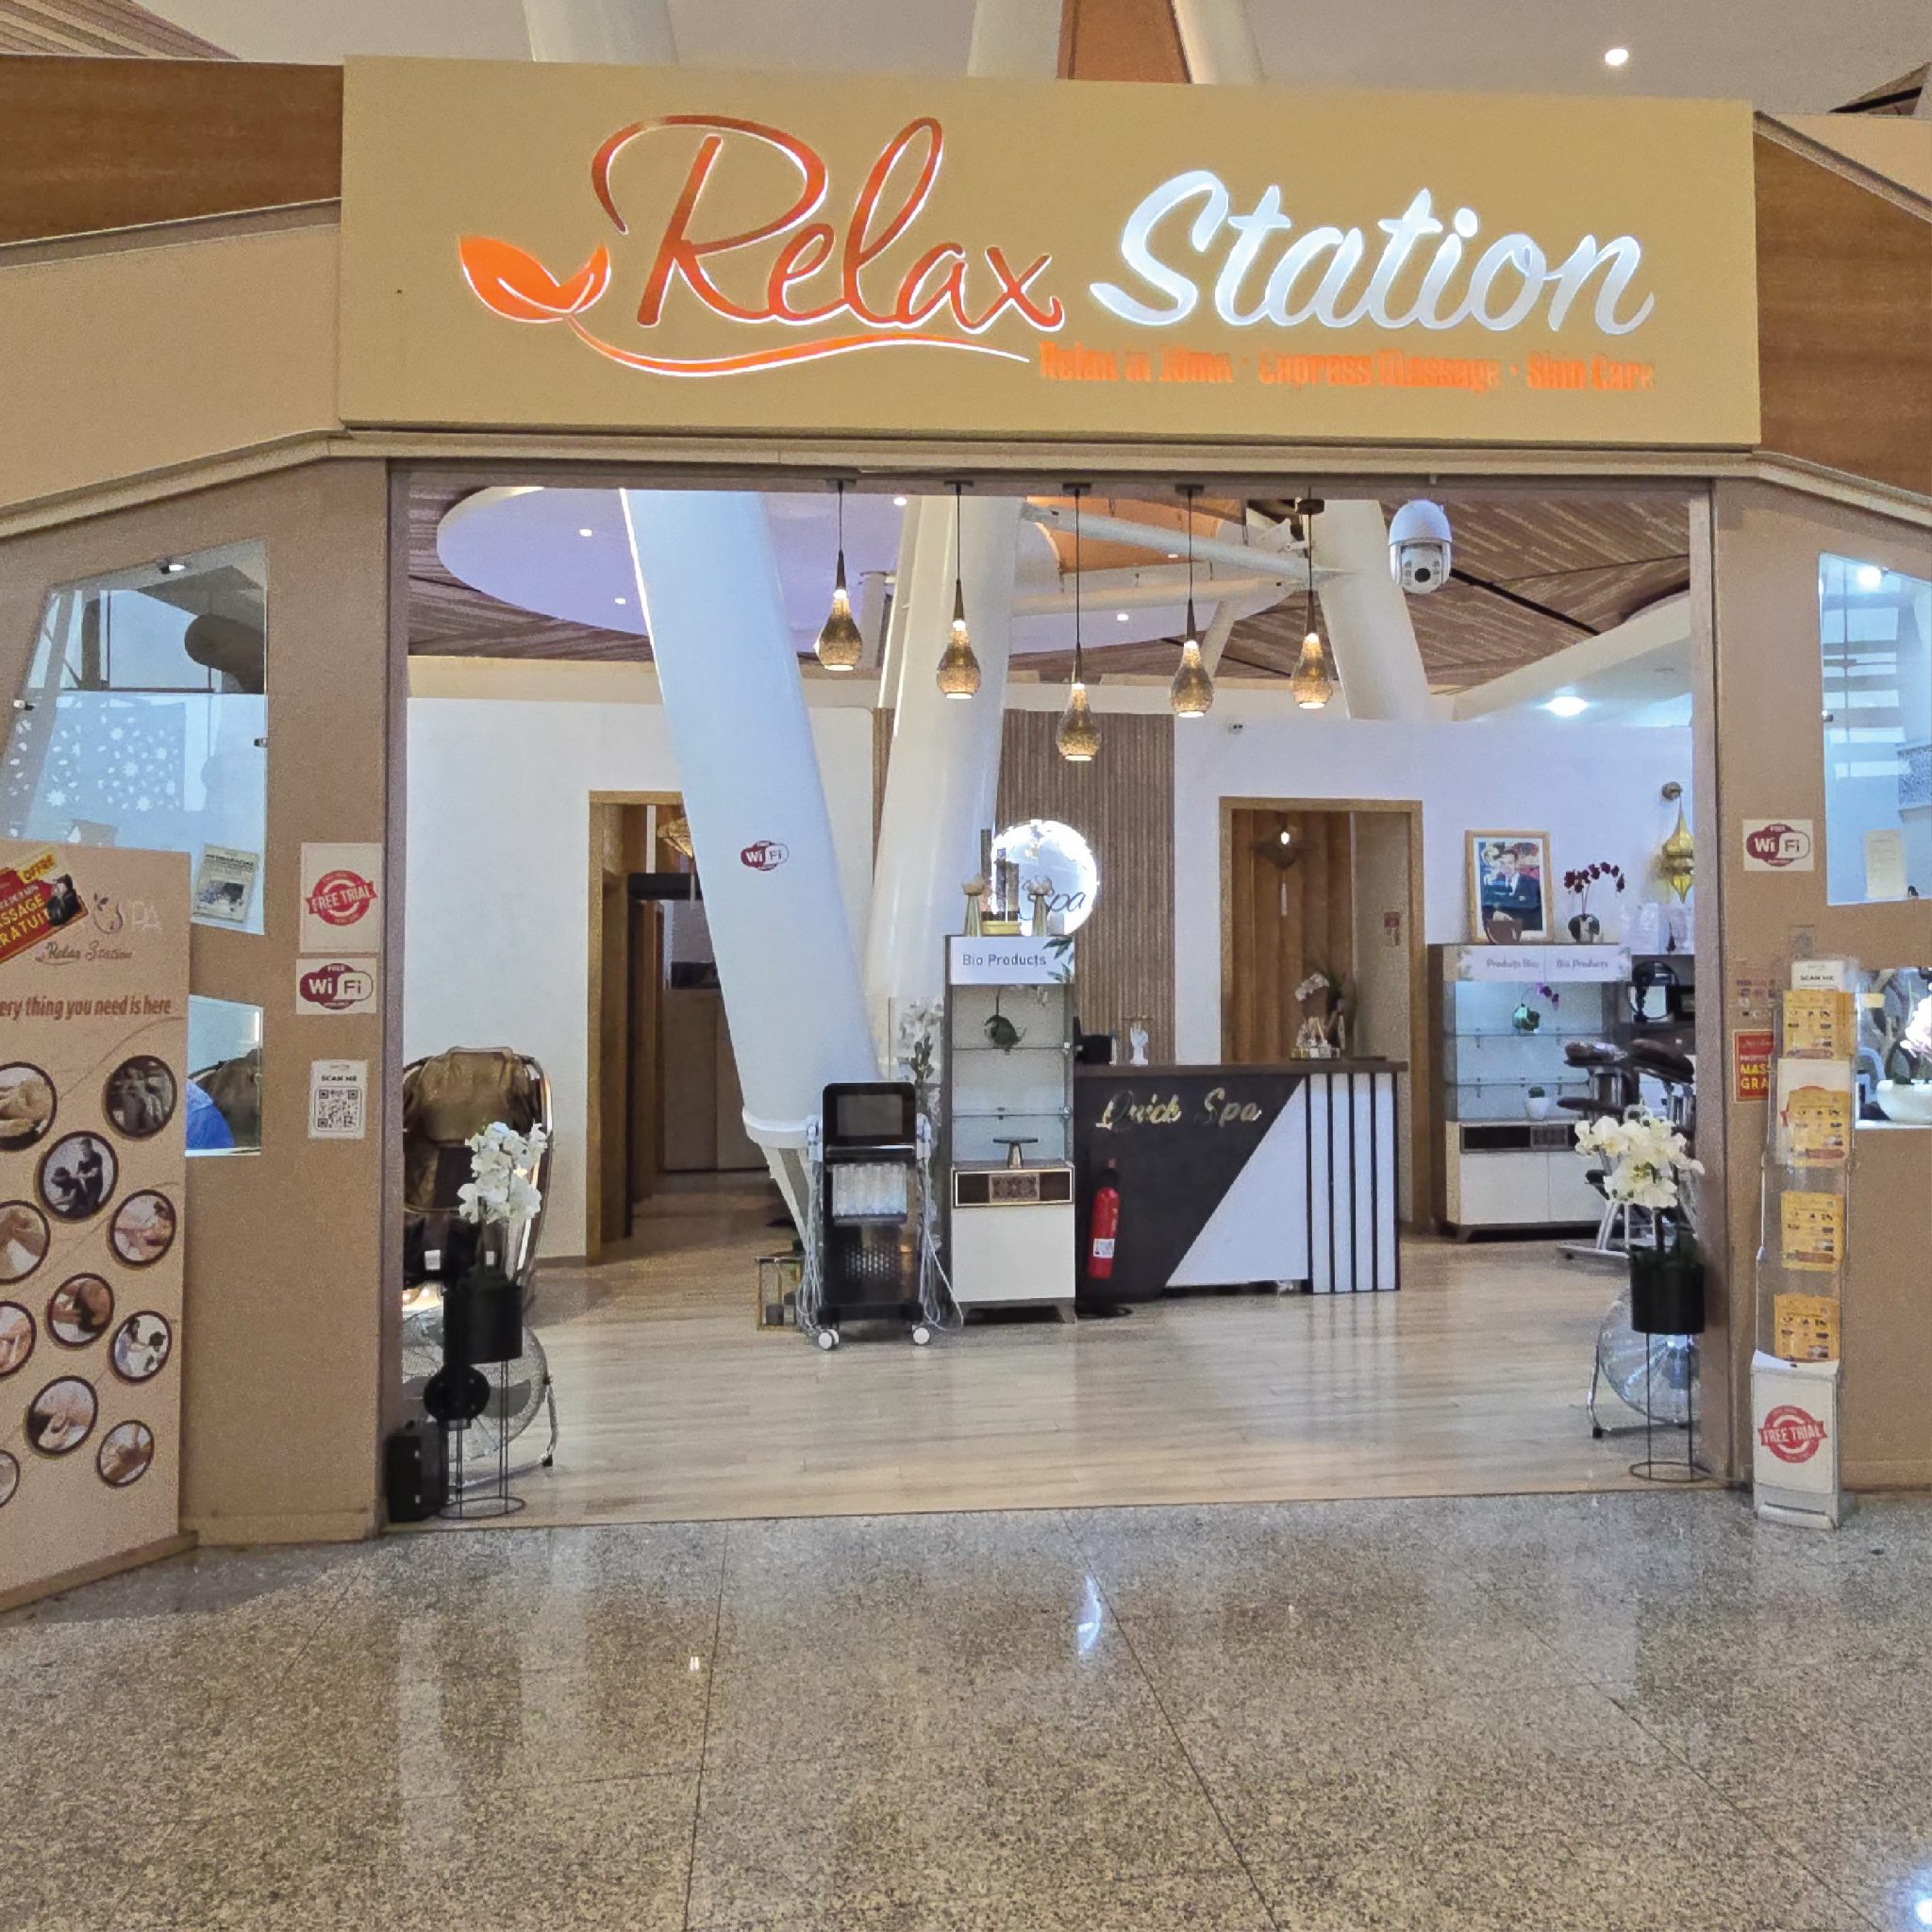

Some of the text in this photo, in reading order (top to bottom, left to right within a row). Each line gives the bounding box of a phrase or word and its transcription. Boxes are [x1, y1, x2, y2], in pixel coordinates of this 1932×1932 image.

[591, 114, 1655, 335] Relax Station
[1257, 349, 1374, 390] Express
[1591, 353, 1654, 391] Care
[311, 884, 372, 912] FREE TRIAL
[962, 951, 1047, 967] Bio Products
[1573, 958, 1609, 970] Products
[25, 995, 64, 1021] thing
[65, 999, 92, 1021] you
[94, 994, 127, 1016] need
[129, 994, 141, 1015] is
[142, 993, 171, 1015] here
[1740, 1063, 1770, 1074] MAS
[1200, 1087, 1262, 1128] Spa
[1762, 1423, 1822, 1444] FREE TRIAL
